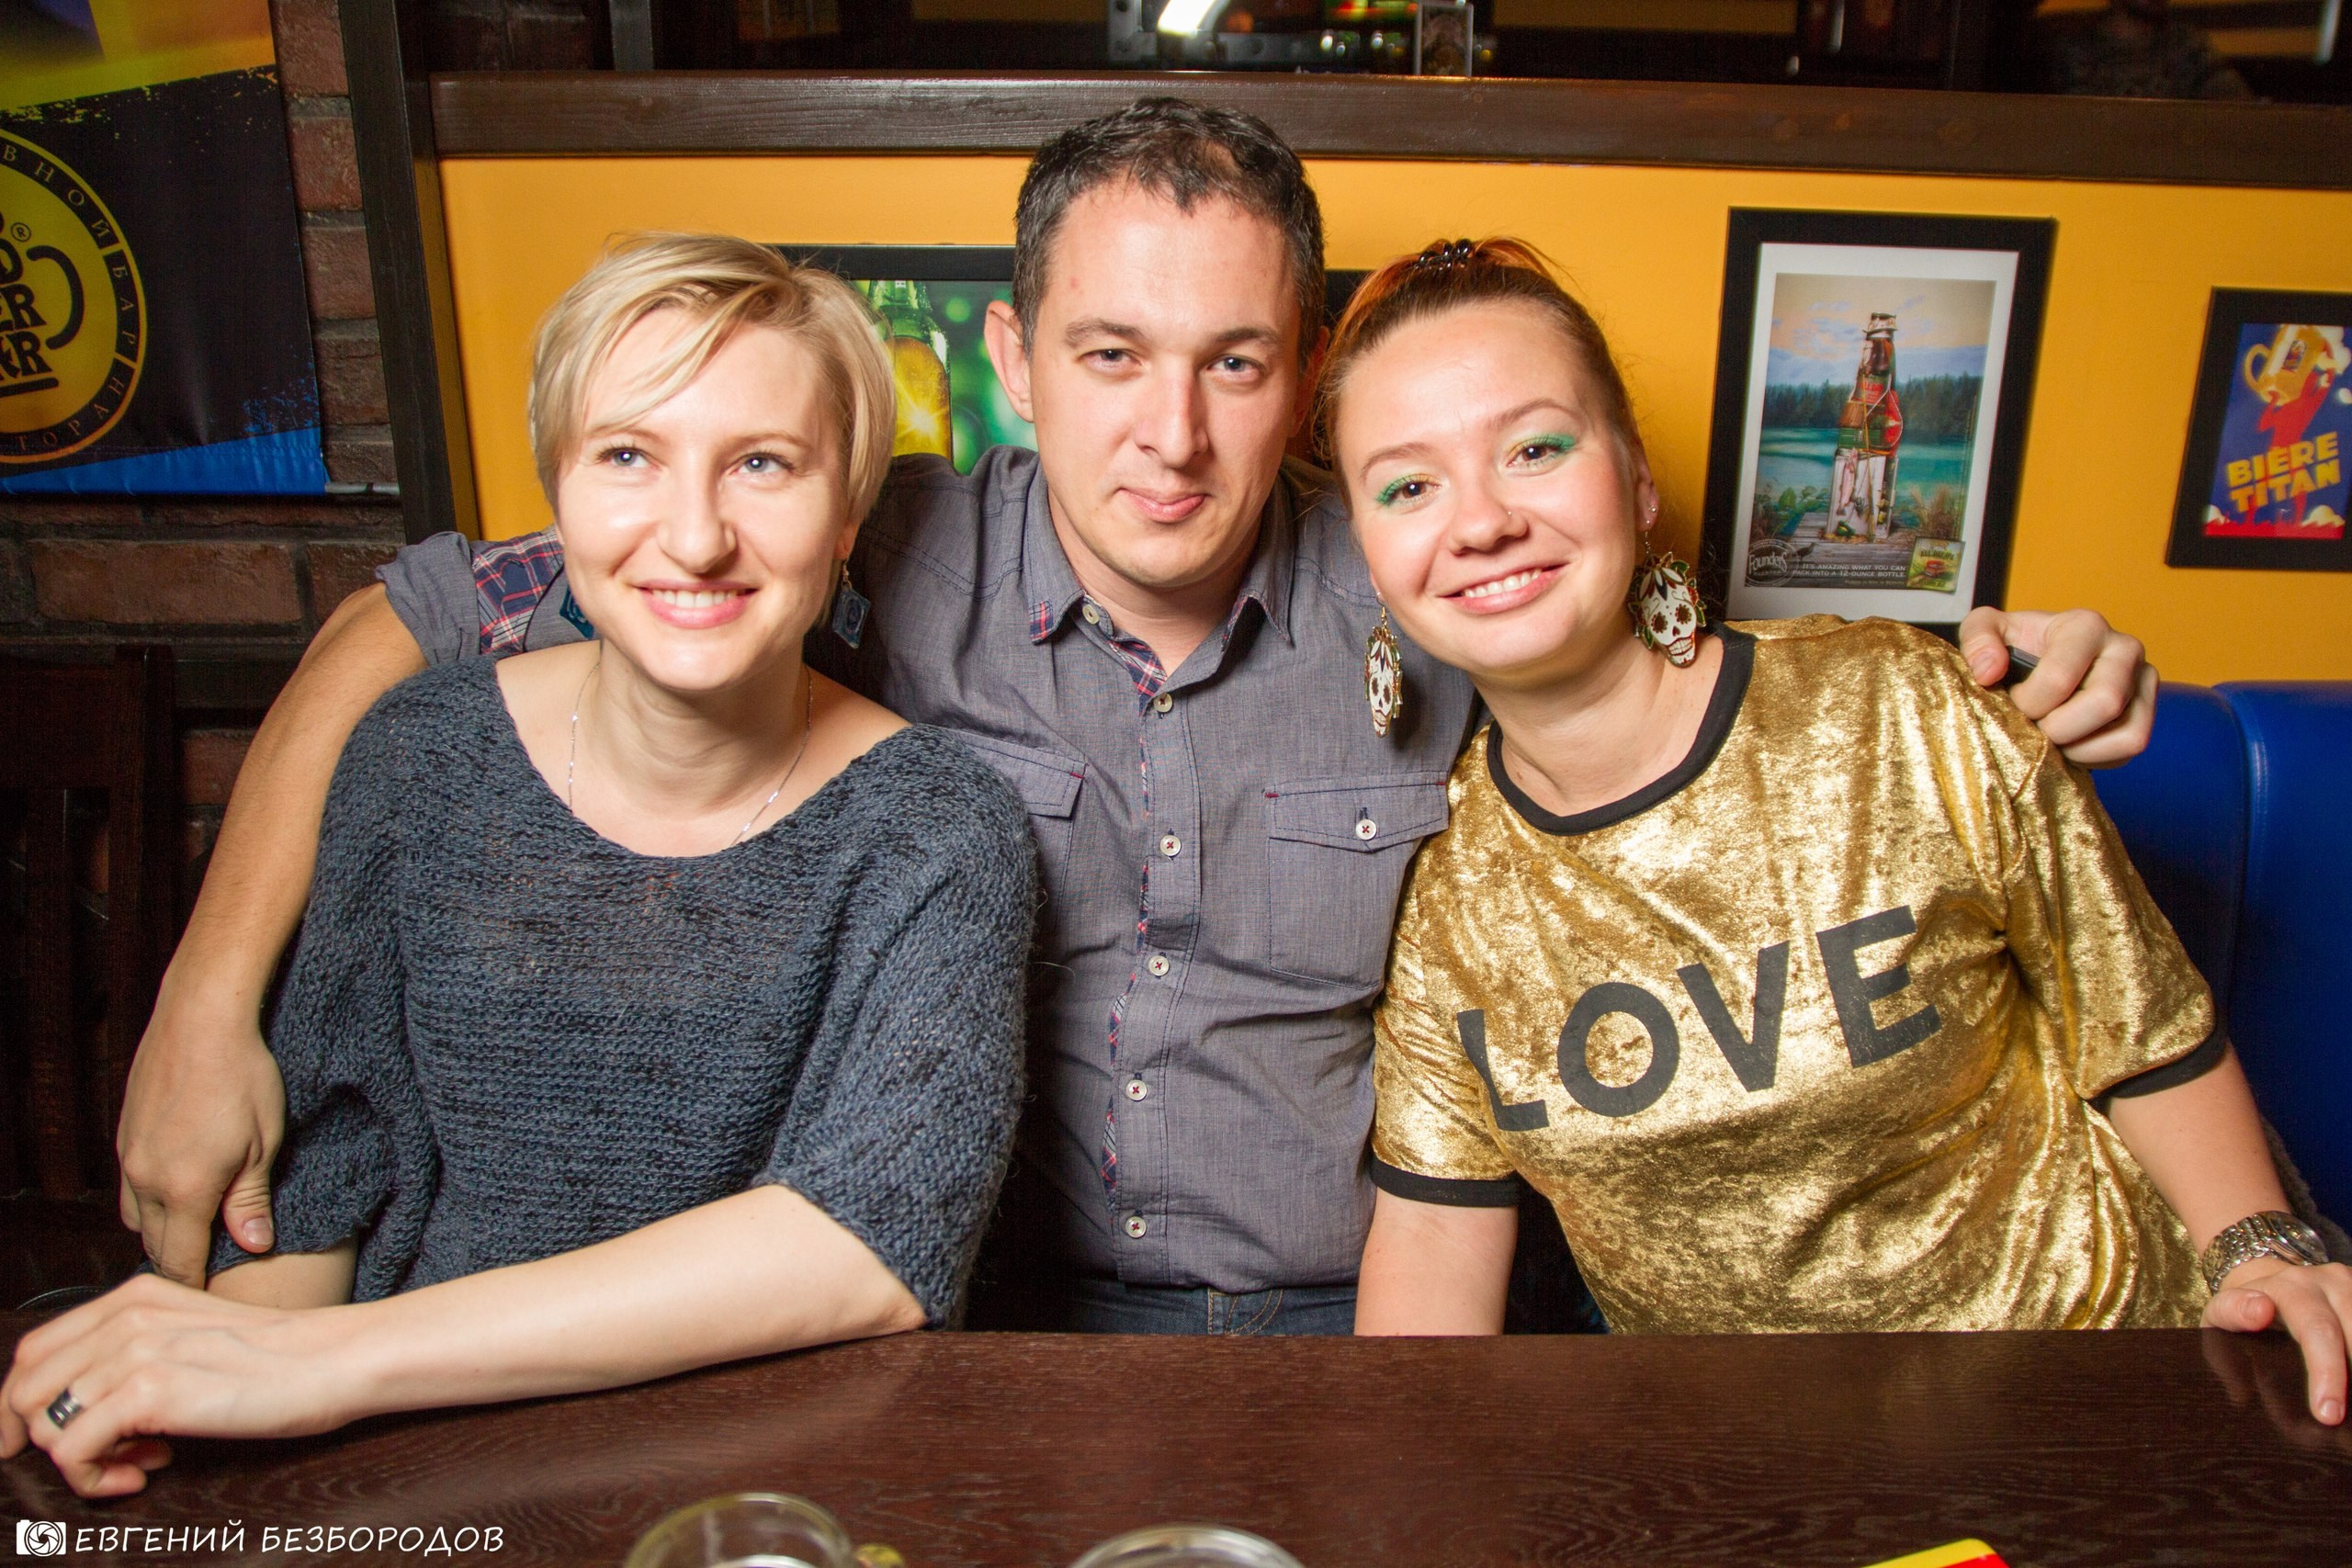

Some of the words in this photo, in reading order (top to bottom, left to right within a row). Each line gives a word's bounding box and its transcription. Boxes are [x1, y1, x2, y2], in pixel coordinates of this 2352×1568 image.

[111, 265, 136, 345] БАР
[2230, 458, 2341, 513] TITAN
[1748, 551, 1788, 575] Founders
[1456, 905, 1942, 1131] LOVE
